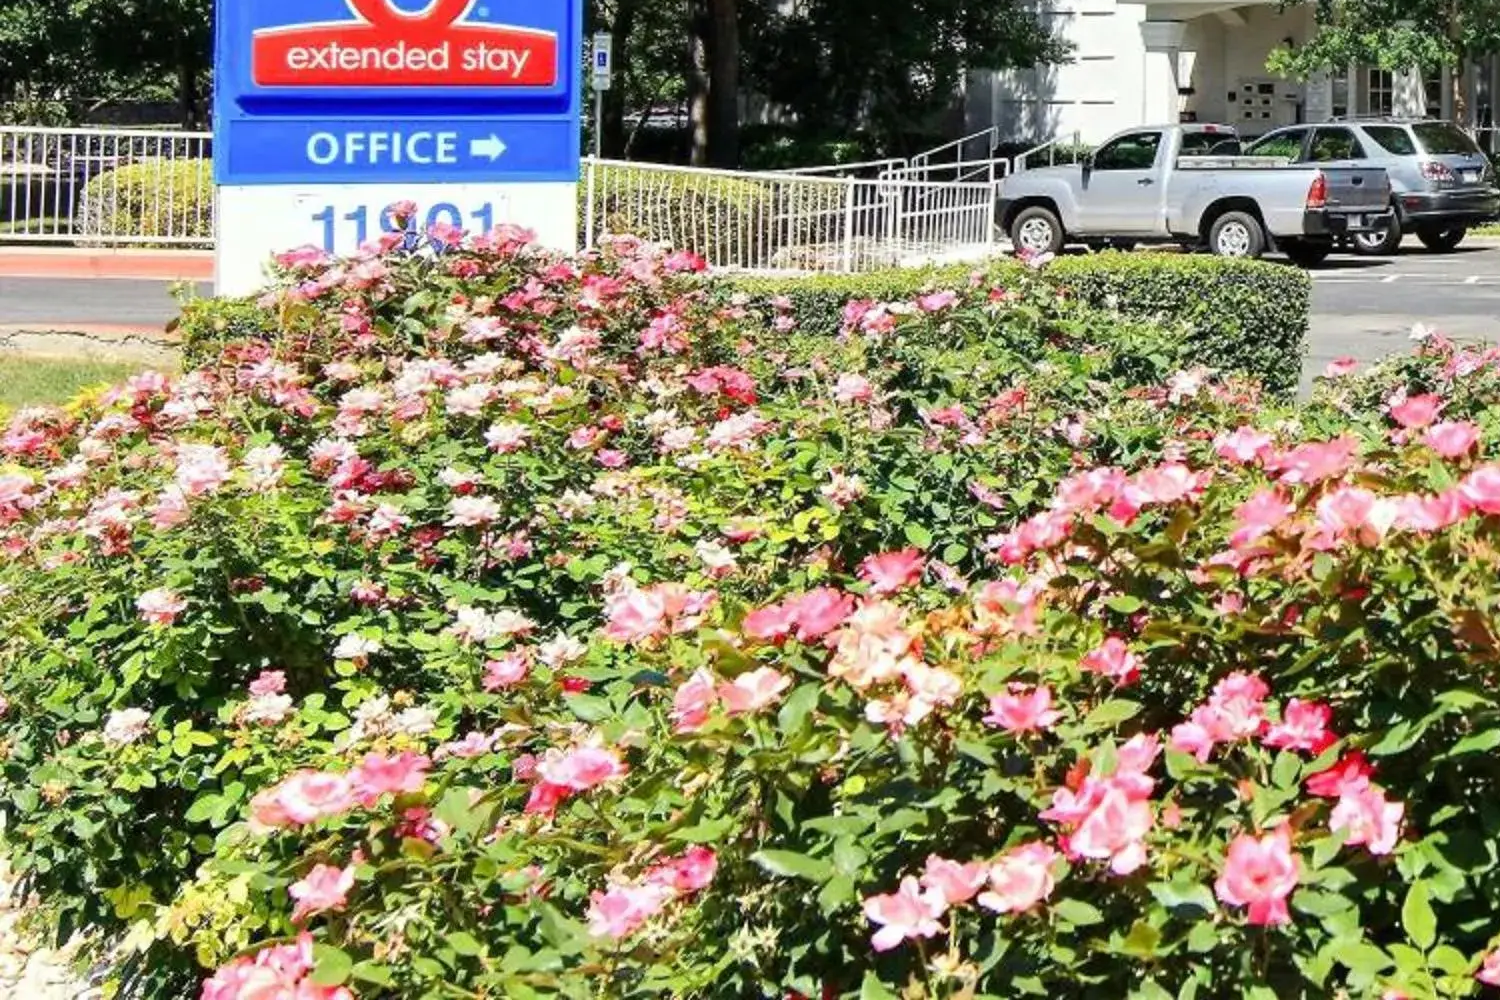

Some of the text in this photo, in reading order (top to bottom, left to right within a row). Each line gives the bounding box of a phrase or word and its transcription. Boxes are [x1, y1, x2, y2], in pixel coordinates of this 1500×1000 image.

[286, 43, 531, 78] extended stay
[306, 133, 456, 164] OFFICE
